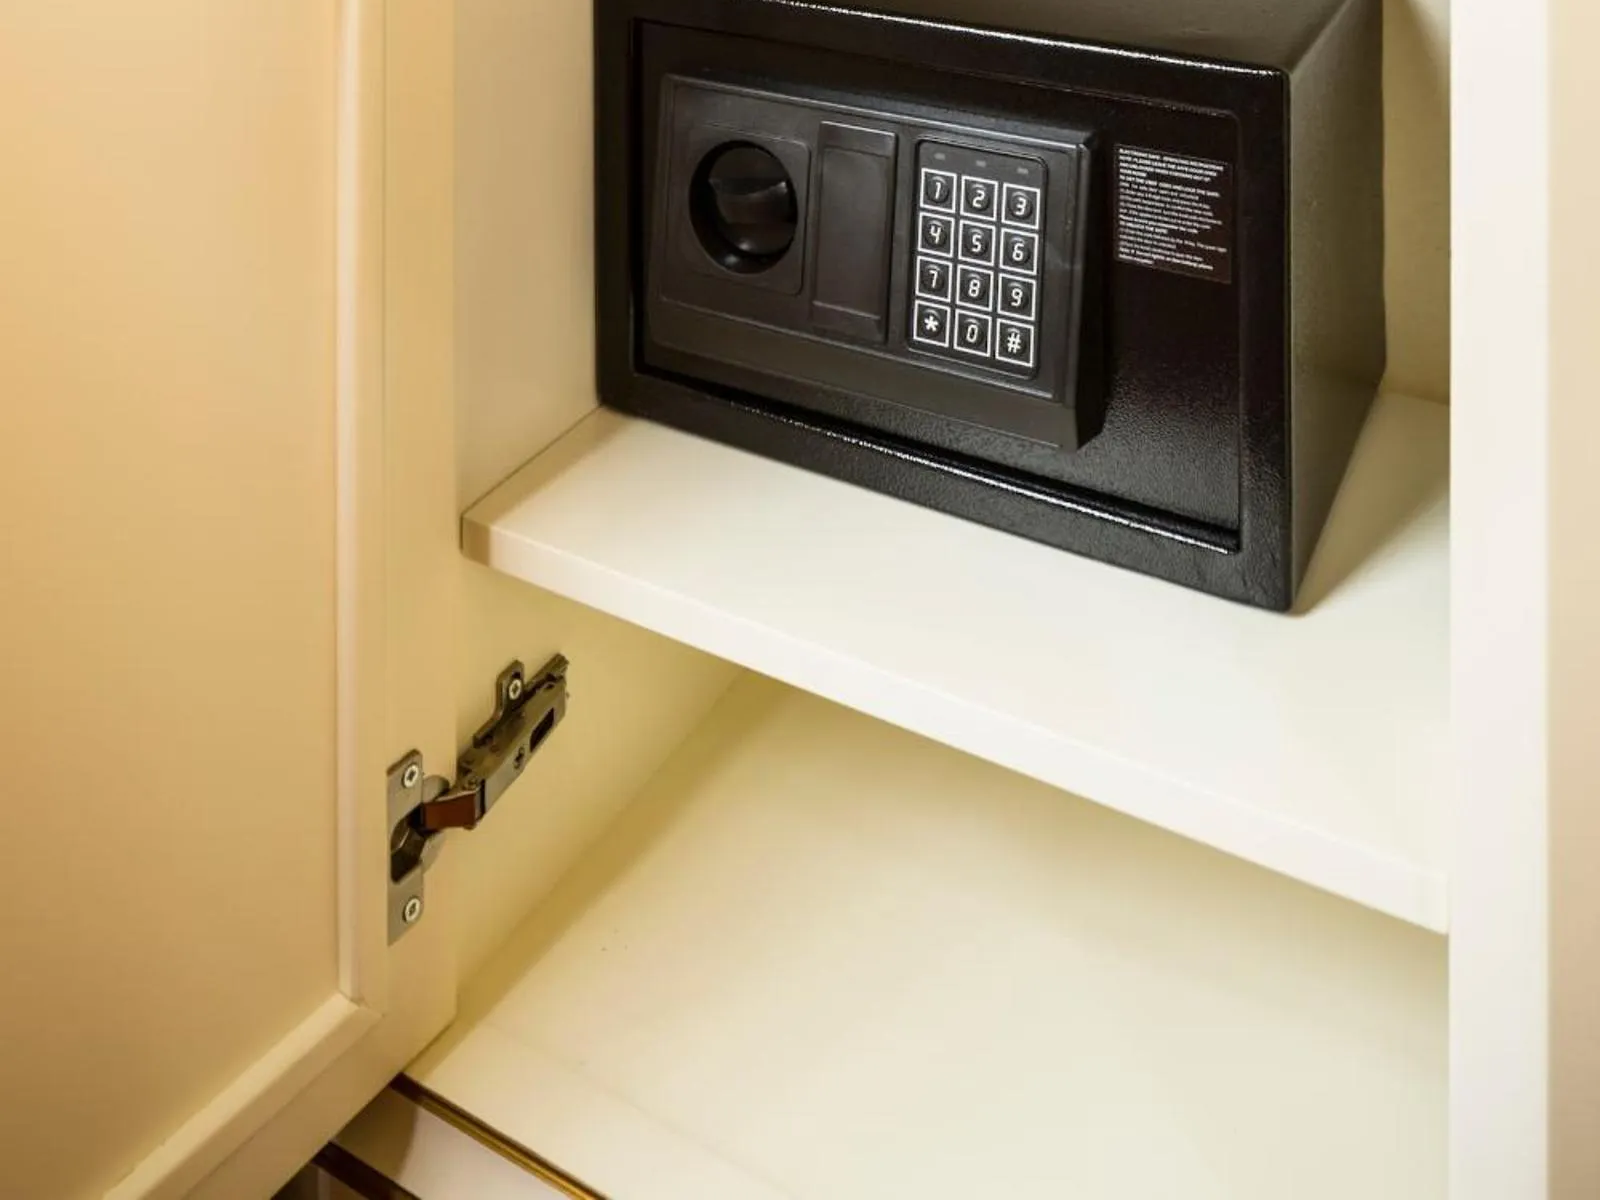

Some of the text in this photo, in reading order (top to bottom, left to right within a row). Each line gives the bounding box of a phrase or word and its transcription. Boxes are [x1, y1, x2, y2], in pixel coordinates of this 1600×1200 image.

[934, 181, 1028, 216] 1 2 3
[929, 225, 1025, 262] 4 5 6
[928, 270, 1024, 307] 7 8 9
[965, 324, 979, 343] 0
[1006, 334, 1022, 354] #
